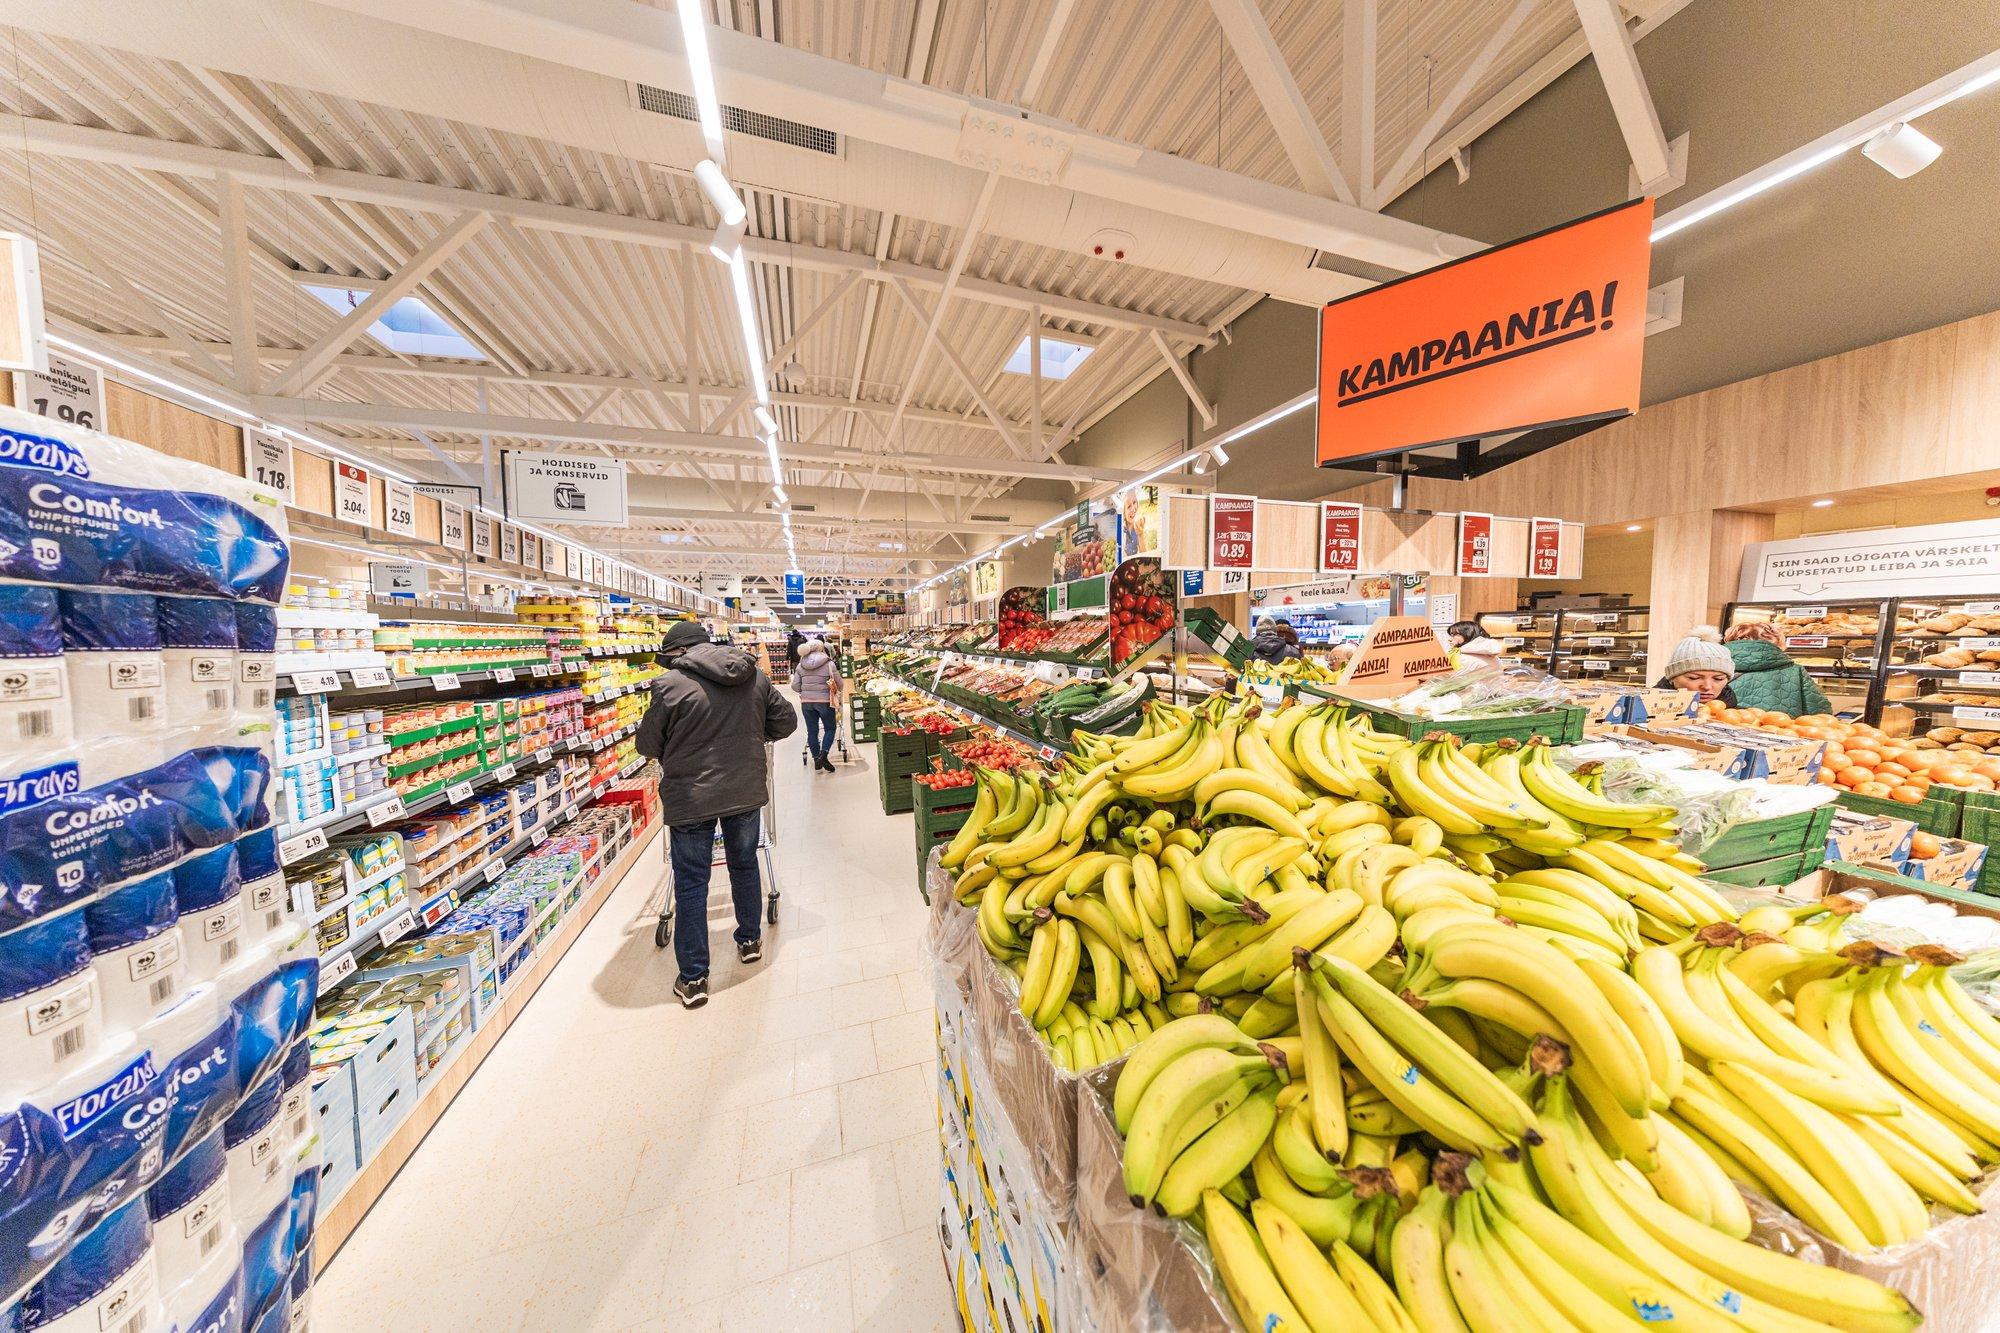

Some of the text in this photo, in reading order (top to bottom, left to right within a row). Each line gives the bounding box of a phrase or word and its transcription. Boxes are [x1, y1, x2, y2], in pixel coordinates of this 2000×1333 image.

[1338, 281, 1618, 397] KAMPAANIA!
[35, 373, 91, 395] eelõigud
[34, 398, 93, 429] 196
[542, 459, 596, 470] HOIDISED
[256, 466, 286, 490] 1.18
[529, 467, 609, 481] JA KONSERVID
[29, 483, 165, 530] Comfort
[344, 499, 362, 514] 3.04
[1215, 501, 1254, 510] KAMPAANIA!
[28, 508, 120, 532] UNPERFUMED
[391, 508, 411, 525] 2.59
[28, 520, 109, 540] toilet paper
[446, 525, 461, 539] 3.09
[37, 547, 57, 560] 10
[1220, 543, 1245, 558] 0.89
[1330, 549, 1352, 564] 0.79
[1772, 559, 1800, 568] SIIN
[1804, 556, 1840, 566] SAAD
[1915, 544, 2000, 557] VÄRSKELT
[1777, 557, 1989, 578] KÜPSETATUD LEIBA JA SAIA
[1225, 571, 1242, 583] 1.79
[1301, 588, 1320, 597] teele
[1373, 626, 1434, 645] KAMPAANIA!
[1404, 656, 1452, 674] KAMPAAN
[320, 676, 335, 686] 4.19
[387, 803, 399, 815] 1.99
[305, 835, 321, 849] 2.19
[52, 842, 87, 860] toilet
[60, 868, 81, 883] 10
[399, 917, 410, 930] 1.50
[337, 958, 351, 975] 1.47
[57, 1058, 154, 1133] Floralys
[122, 1046, 227, 1130] Cofort
[54, 1215, 69, 1236] 3
